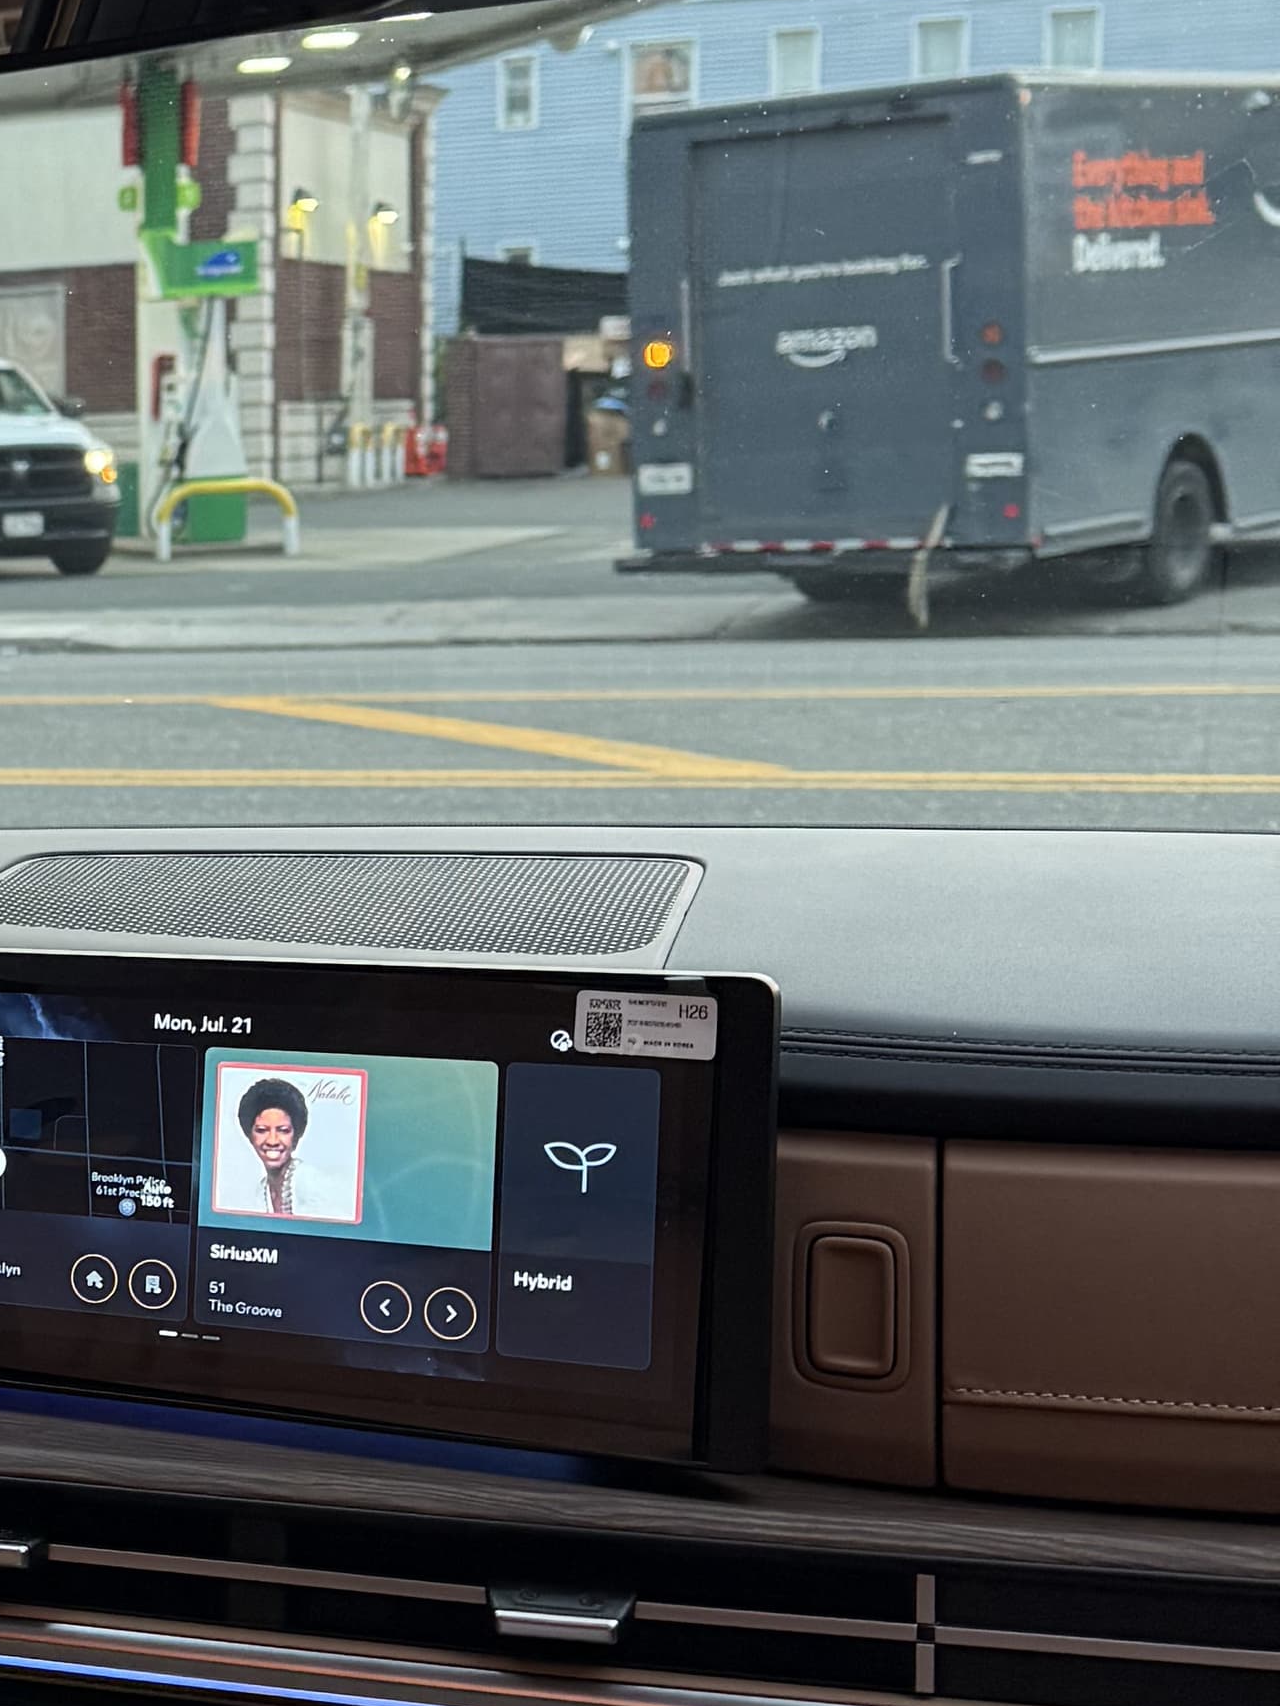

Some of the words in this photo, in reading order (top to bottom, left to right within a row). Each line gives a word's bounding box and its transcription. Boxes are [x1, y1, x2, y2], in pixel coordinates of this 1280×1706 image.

[775, 325, 879, 356] amazon
[678, 1004, 709, 1020] H26
[154, 1013, 197, 1034] Mon,
[200, 1015, 228, 1033] Jul.
[231, 1016, 252, 1034] 21
[307, 1078, 354, 1106] Natalie
[91, 1171, 134, 1186] Brooklyn
[95, 1185, 117, 1196] 61st
[140, 1194, 162, 1207] 150
[162, 1196, 175, 1208] ft
[209, 1244, 278, 1264] SiriusXM
[209, 1281, 225, 1294] 51
[513, 1271, 572, 1292] Hybrid
[208, 1299, 234, 1313] The
[235, 1301, 282, 1318] Groove
